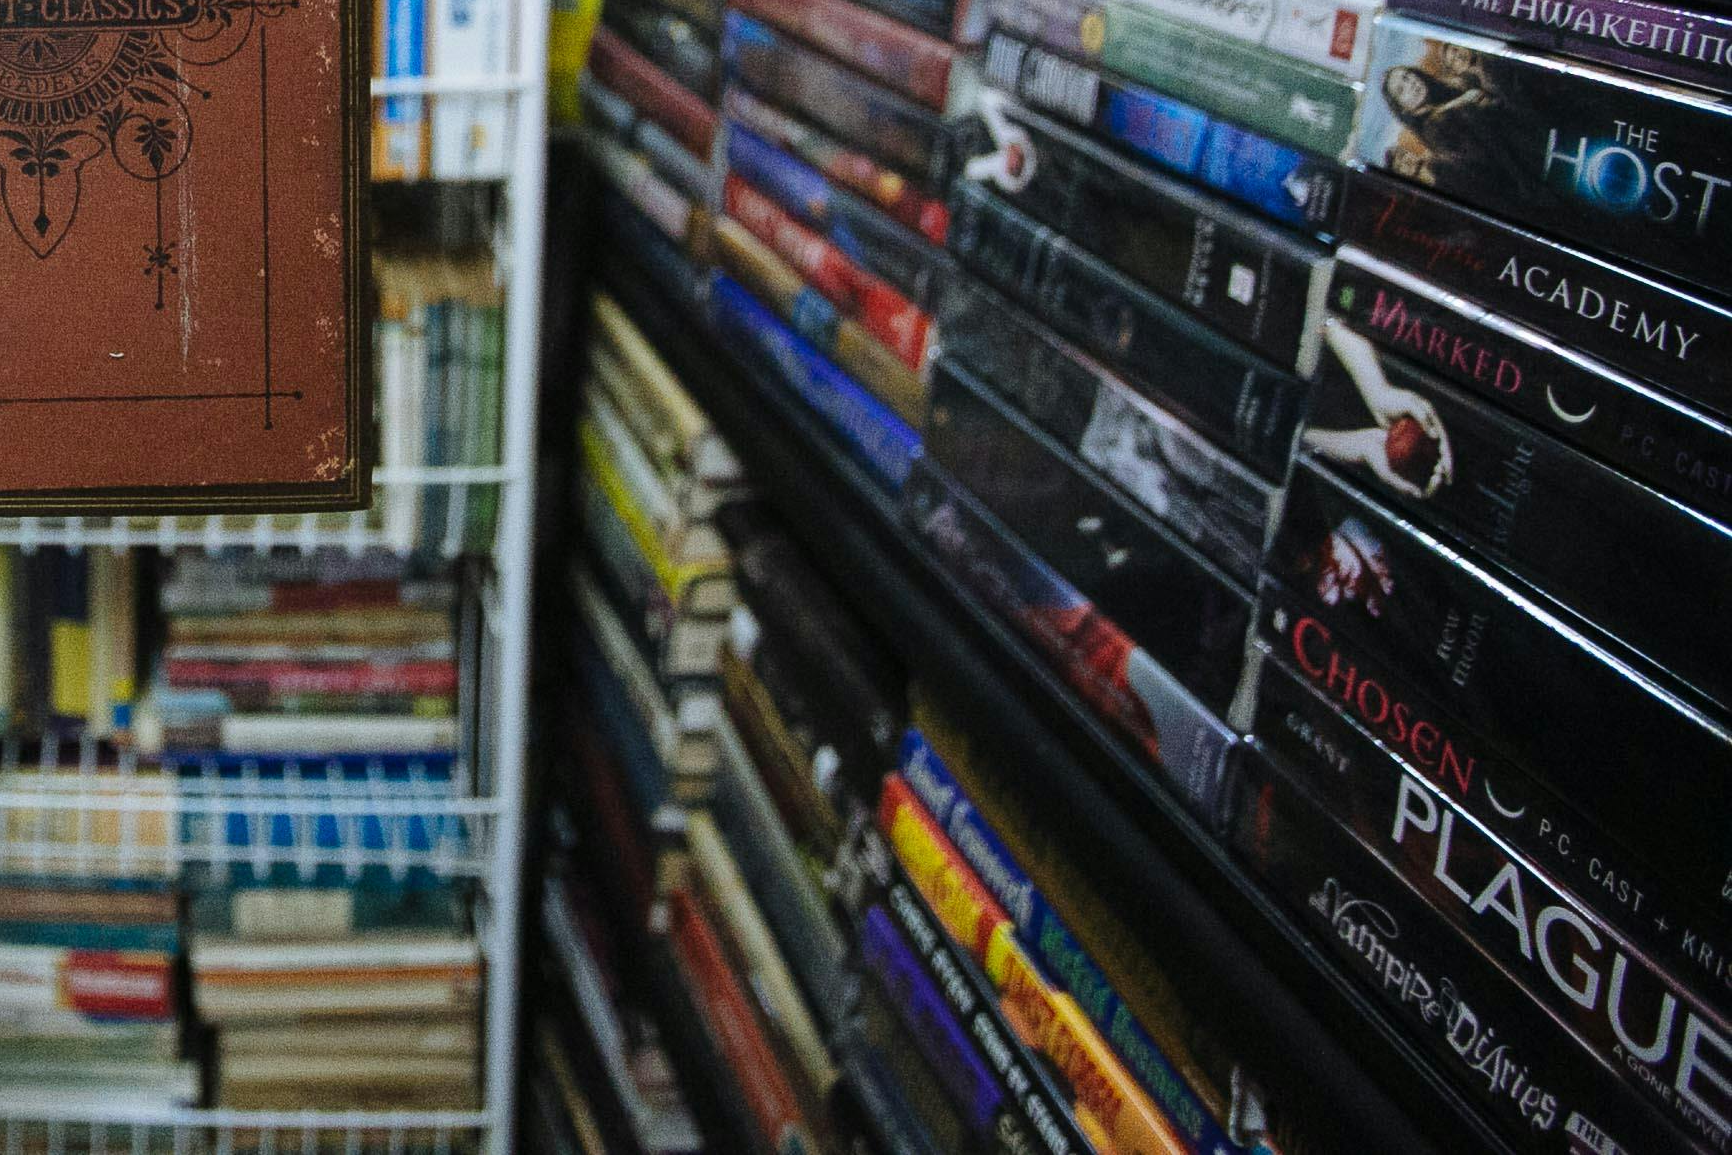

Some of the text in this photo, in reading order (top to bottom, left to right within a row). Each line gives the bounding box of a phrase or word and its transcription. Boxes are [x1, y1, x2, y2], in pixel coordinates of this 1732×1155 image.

[1542, 126, 1732, 232] HOST
[1614, 119, 1659, 154] THE
[1371, 289, 1523, 395] MARKED
[1497, 254, 1700, 361] ACADEMY
[1436, 608, 1461, 661] new
[1451, 612, 1490, 687] moon
[1292, 615, 1476, 797] CHOSEN
[1588, 856, 1646, 914] CAST
[1390, 772, 1732, 1138] PLAGUE
[1626, 1055, 1673, 1101] GONE
[1674, 1095, 1728, 1150] NOVEL
